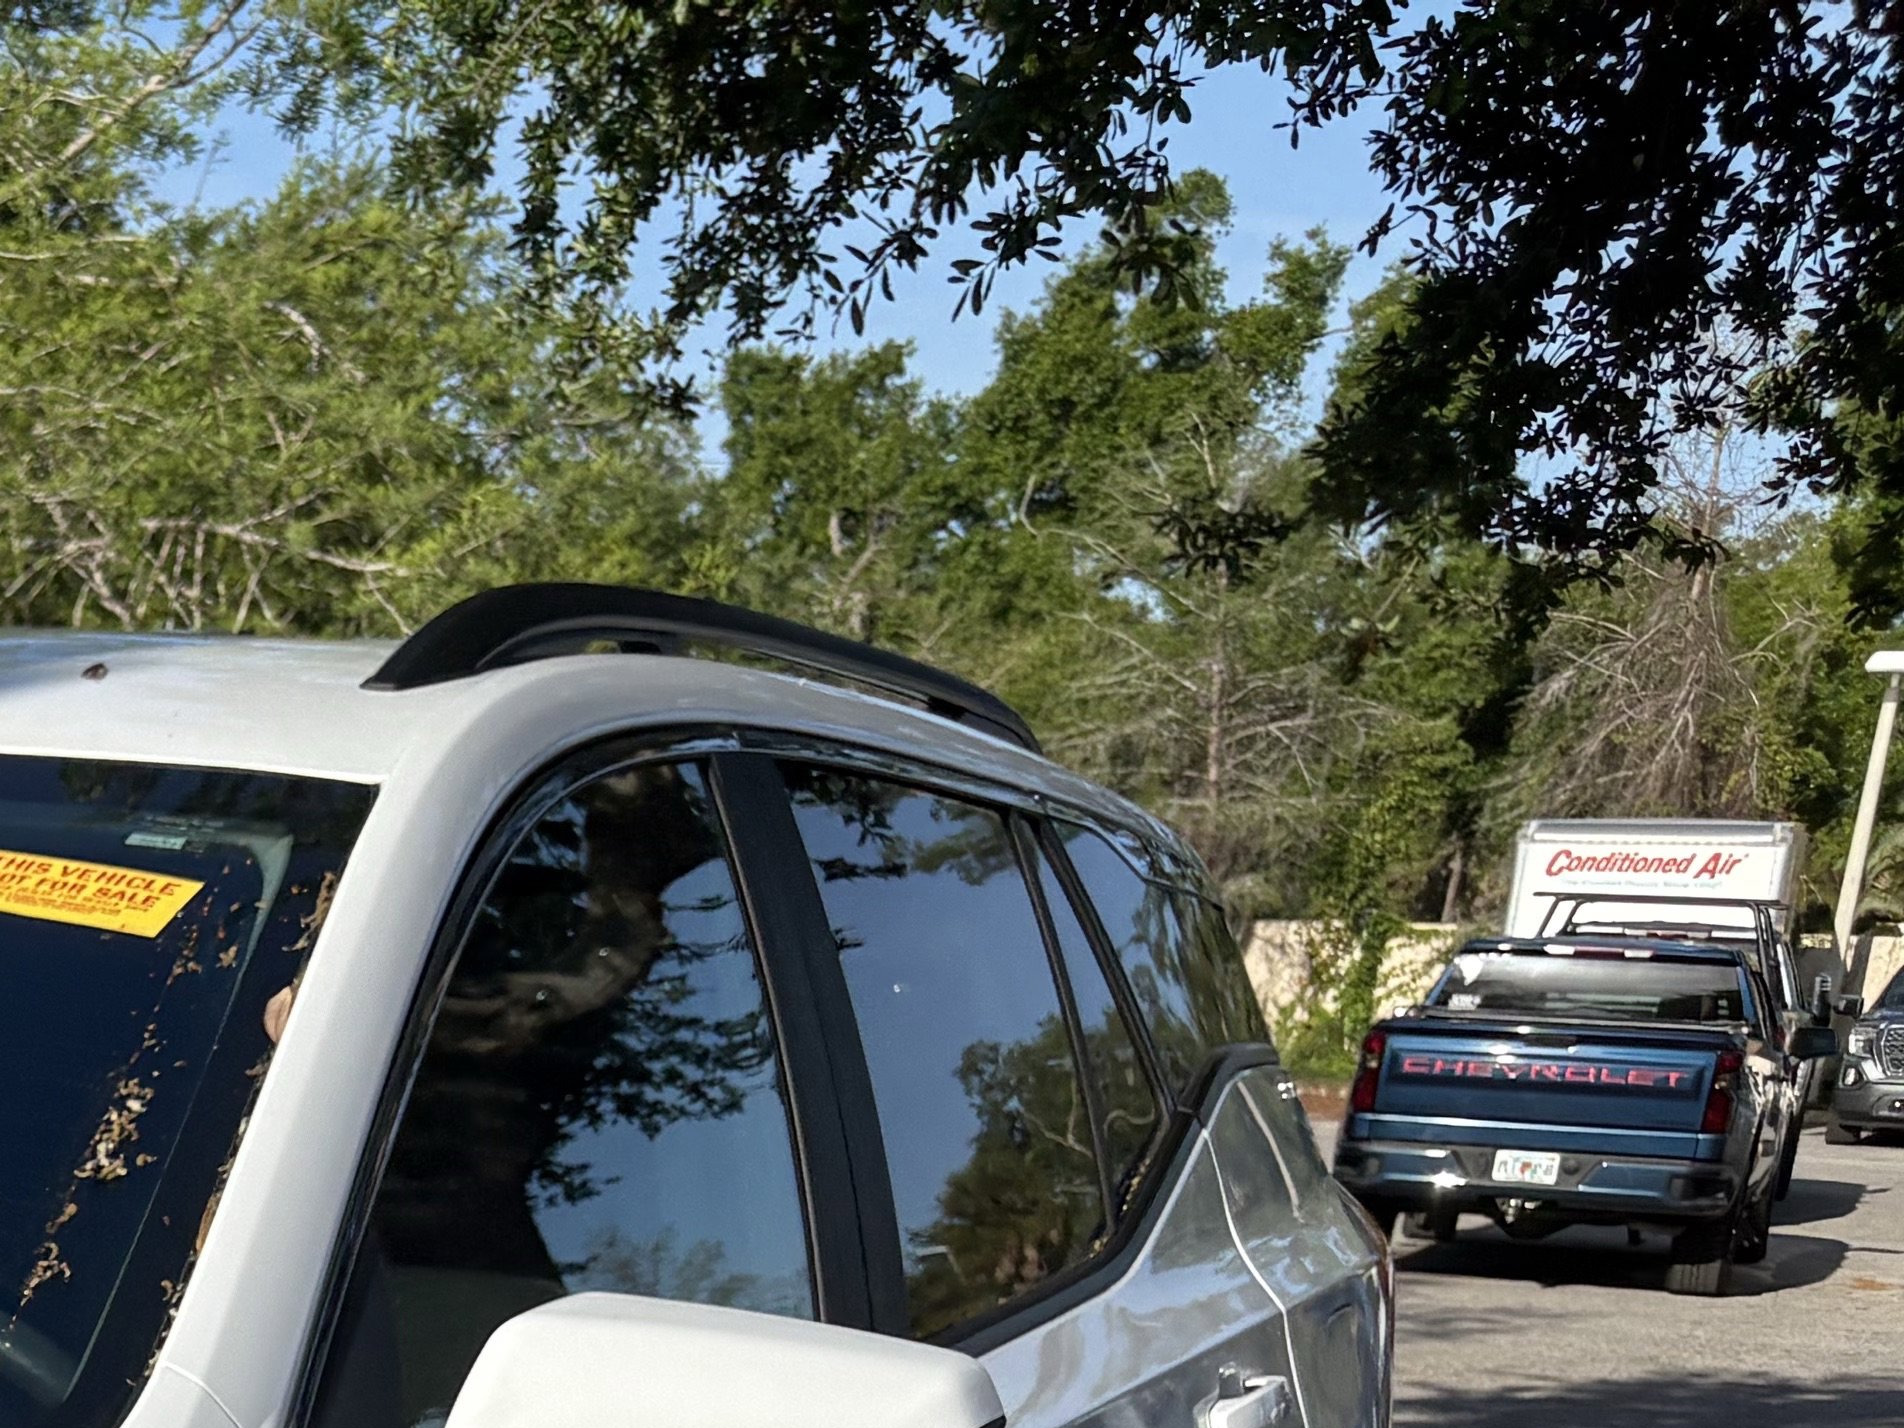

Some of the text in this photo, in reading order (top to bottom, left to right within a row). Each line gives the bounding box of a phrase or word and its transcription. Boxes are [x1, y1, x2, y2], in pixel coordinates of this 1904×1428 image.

[1546, 849, 1743, 879] Conditioned Air
[34, 876, 87, 894] FOR
[92, 886, 162, 908] SALE
[61, 864, 182, 897] VEHICLE
[1401, 1056, 1689, 1088] CHEVROLET
